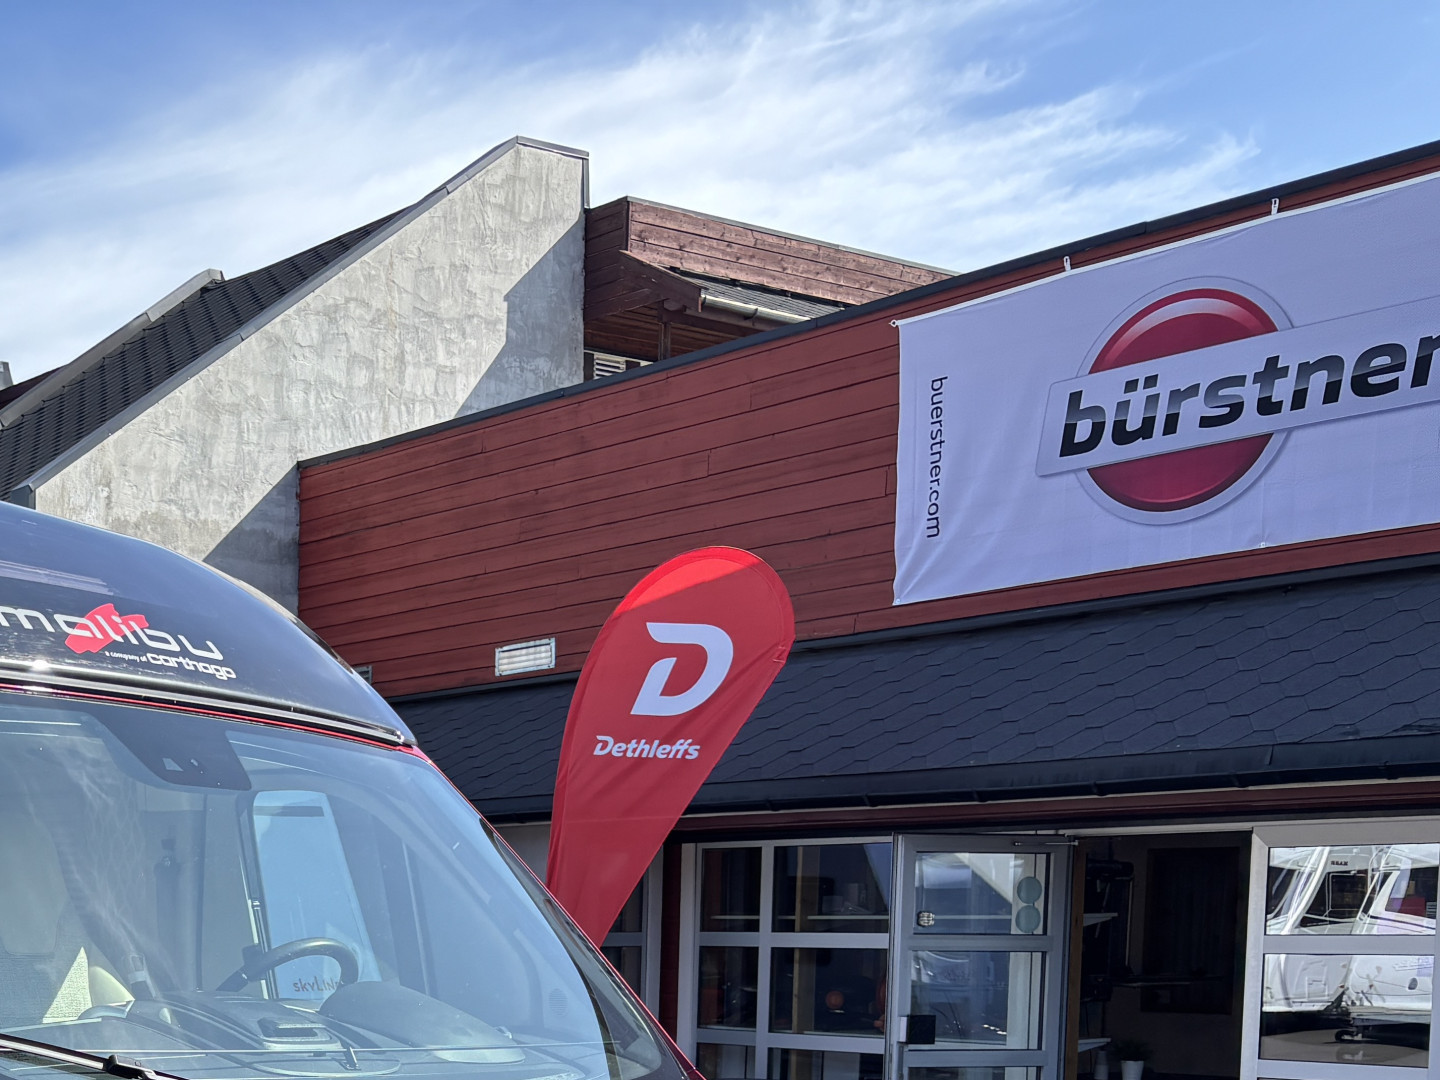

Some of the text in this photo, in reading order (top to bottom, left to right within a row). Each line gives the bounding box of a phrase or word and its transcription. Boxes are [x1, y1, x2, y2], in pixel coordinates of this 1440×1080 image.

[1059, 333, 1440, 459] bürstner
[926, 375, 949, 539] buerstner.com
[146, 652, 238, 681] carthago
[593, 734, 701, 761] Dethleffs
